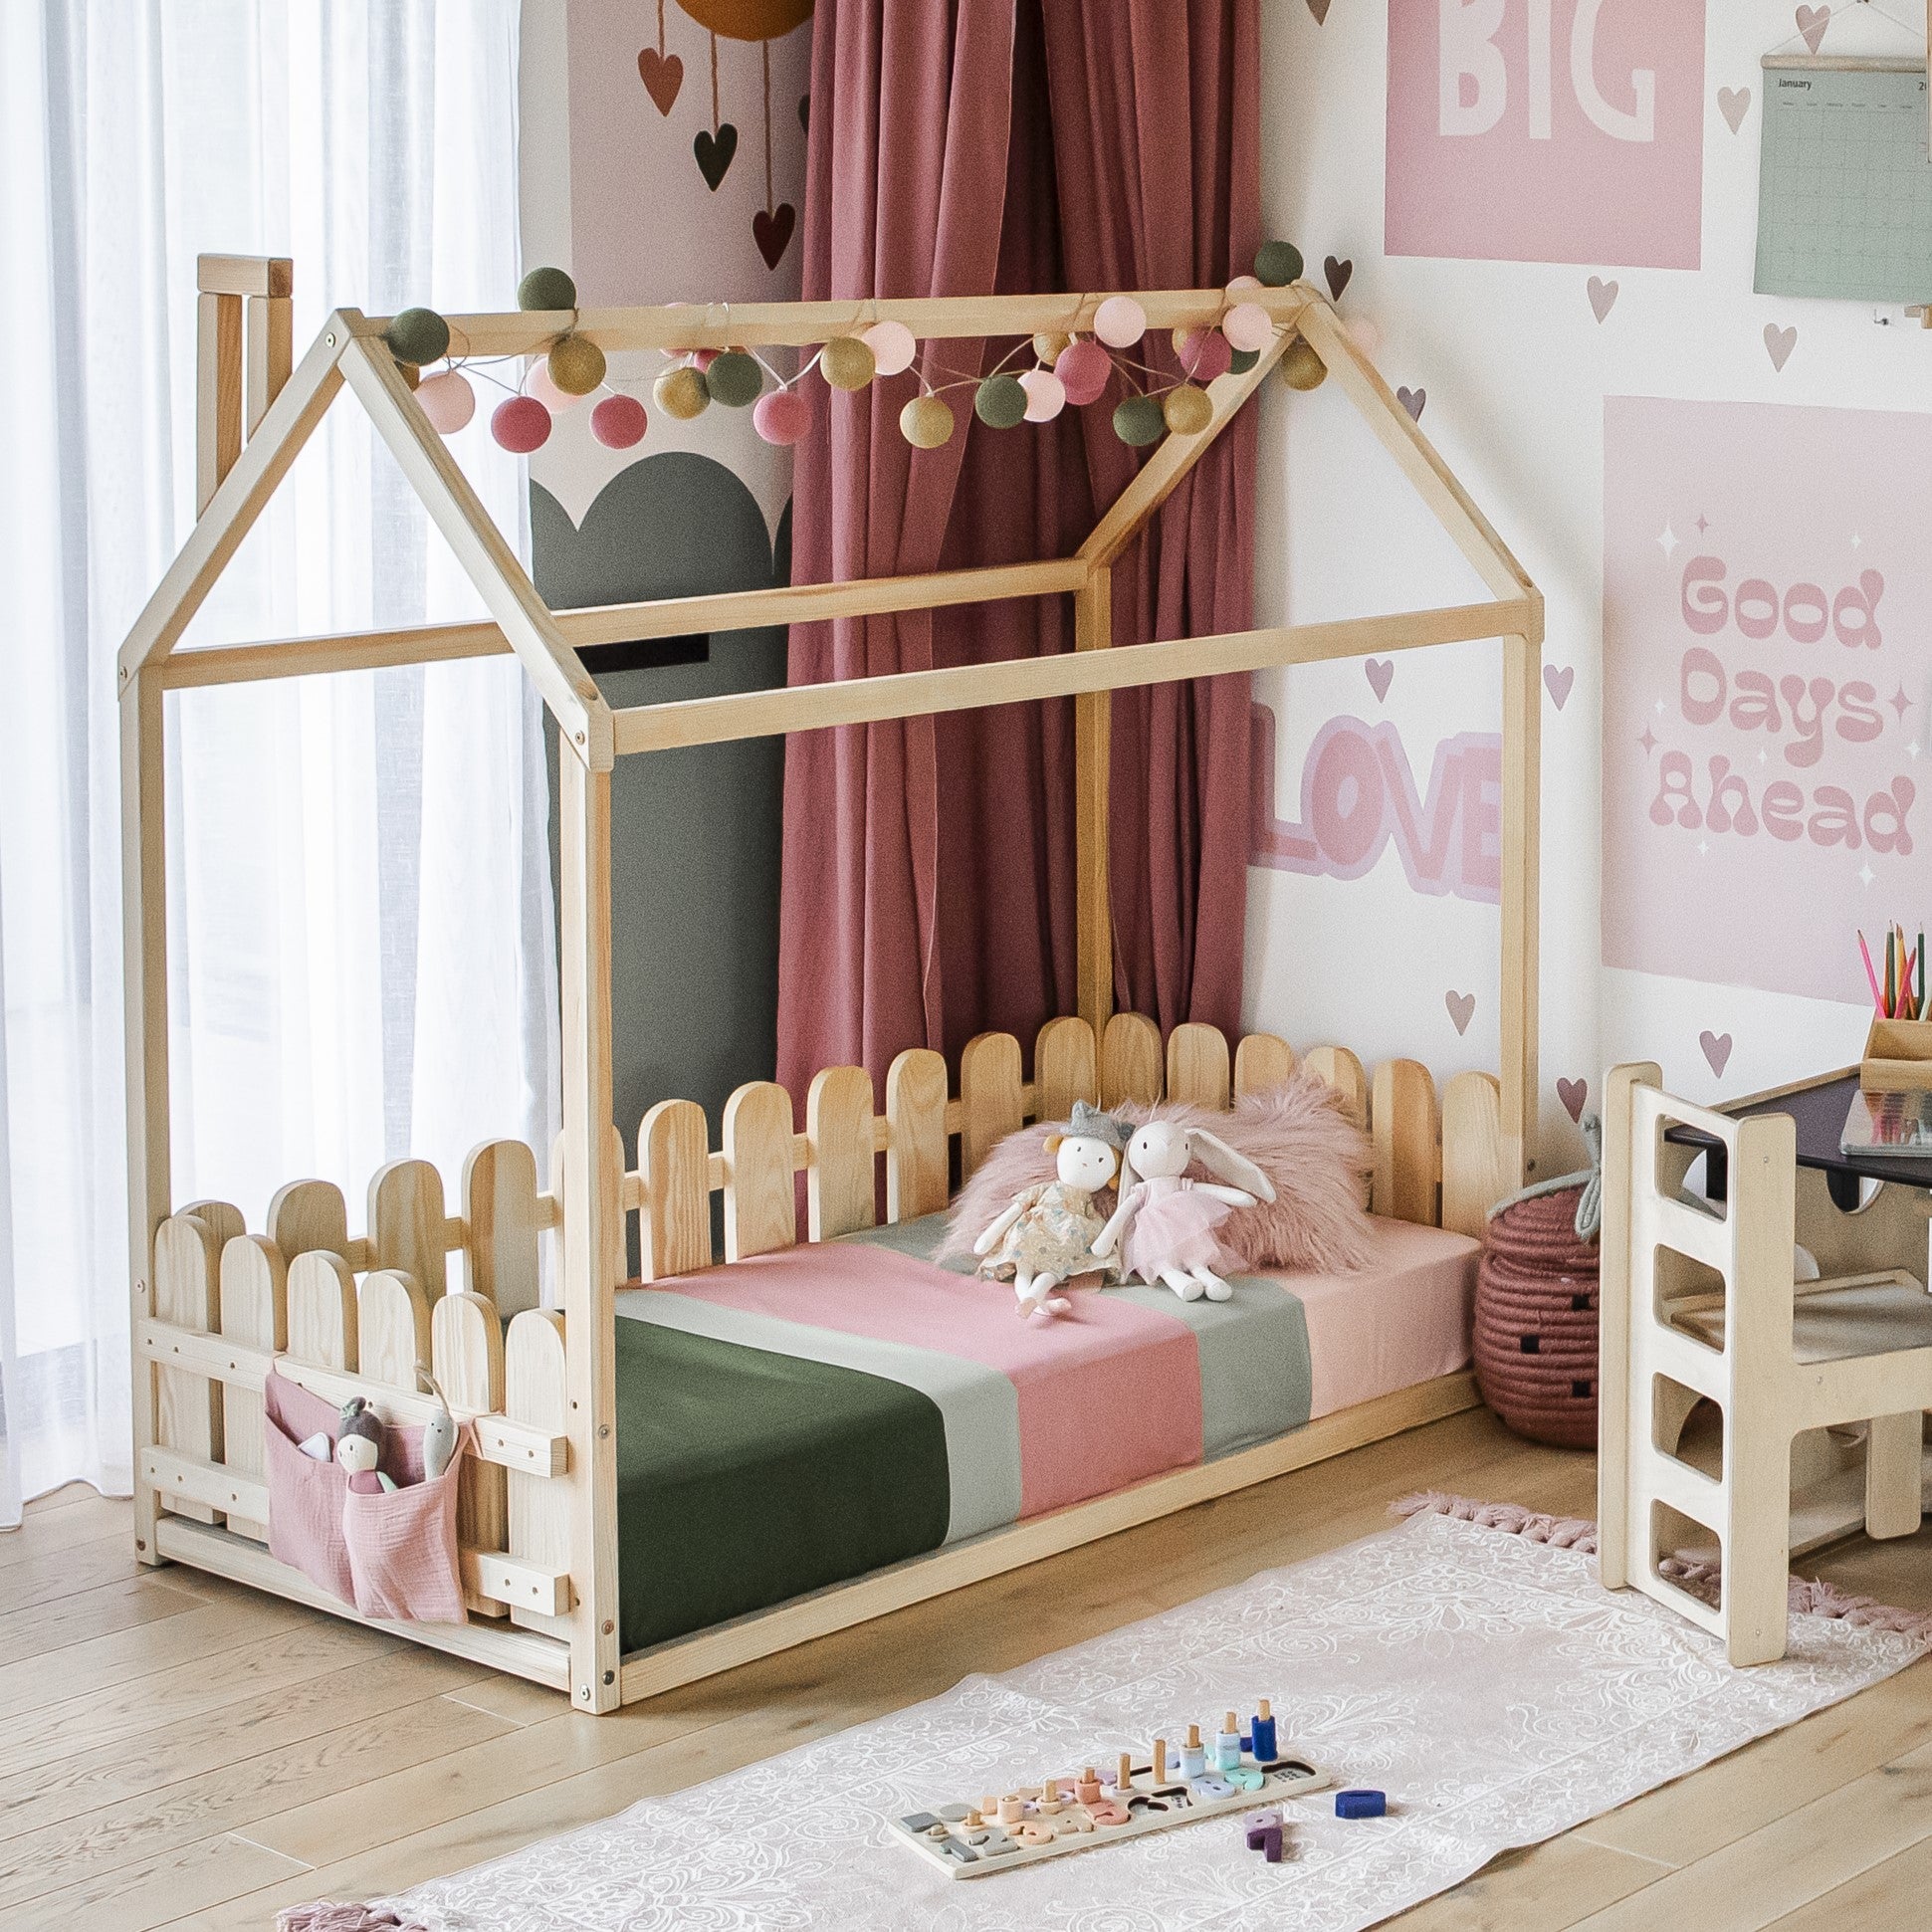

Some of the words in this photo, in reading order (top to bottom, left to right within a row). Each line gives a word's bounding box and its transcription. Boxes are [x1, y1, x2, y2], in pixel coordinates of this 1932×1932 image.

[1439, 0, 1656, 142] BIG
[1779, 79, 1812, 92] January
[1680, 554, 1885, 651] Good
[1679, 646, 1885, 768] Days
[1248, 702, 1502, 905] LOVE
[1648, 750, 1917, 857] Ahead
